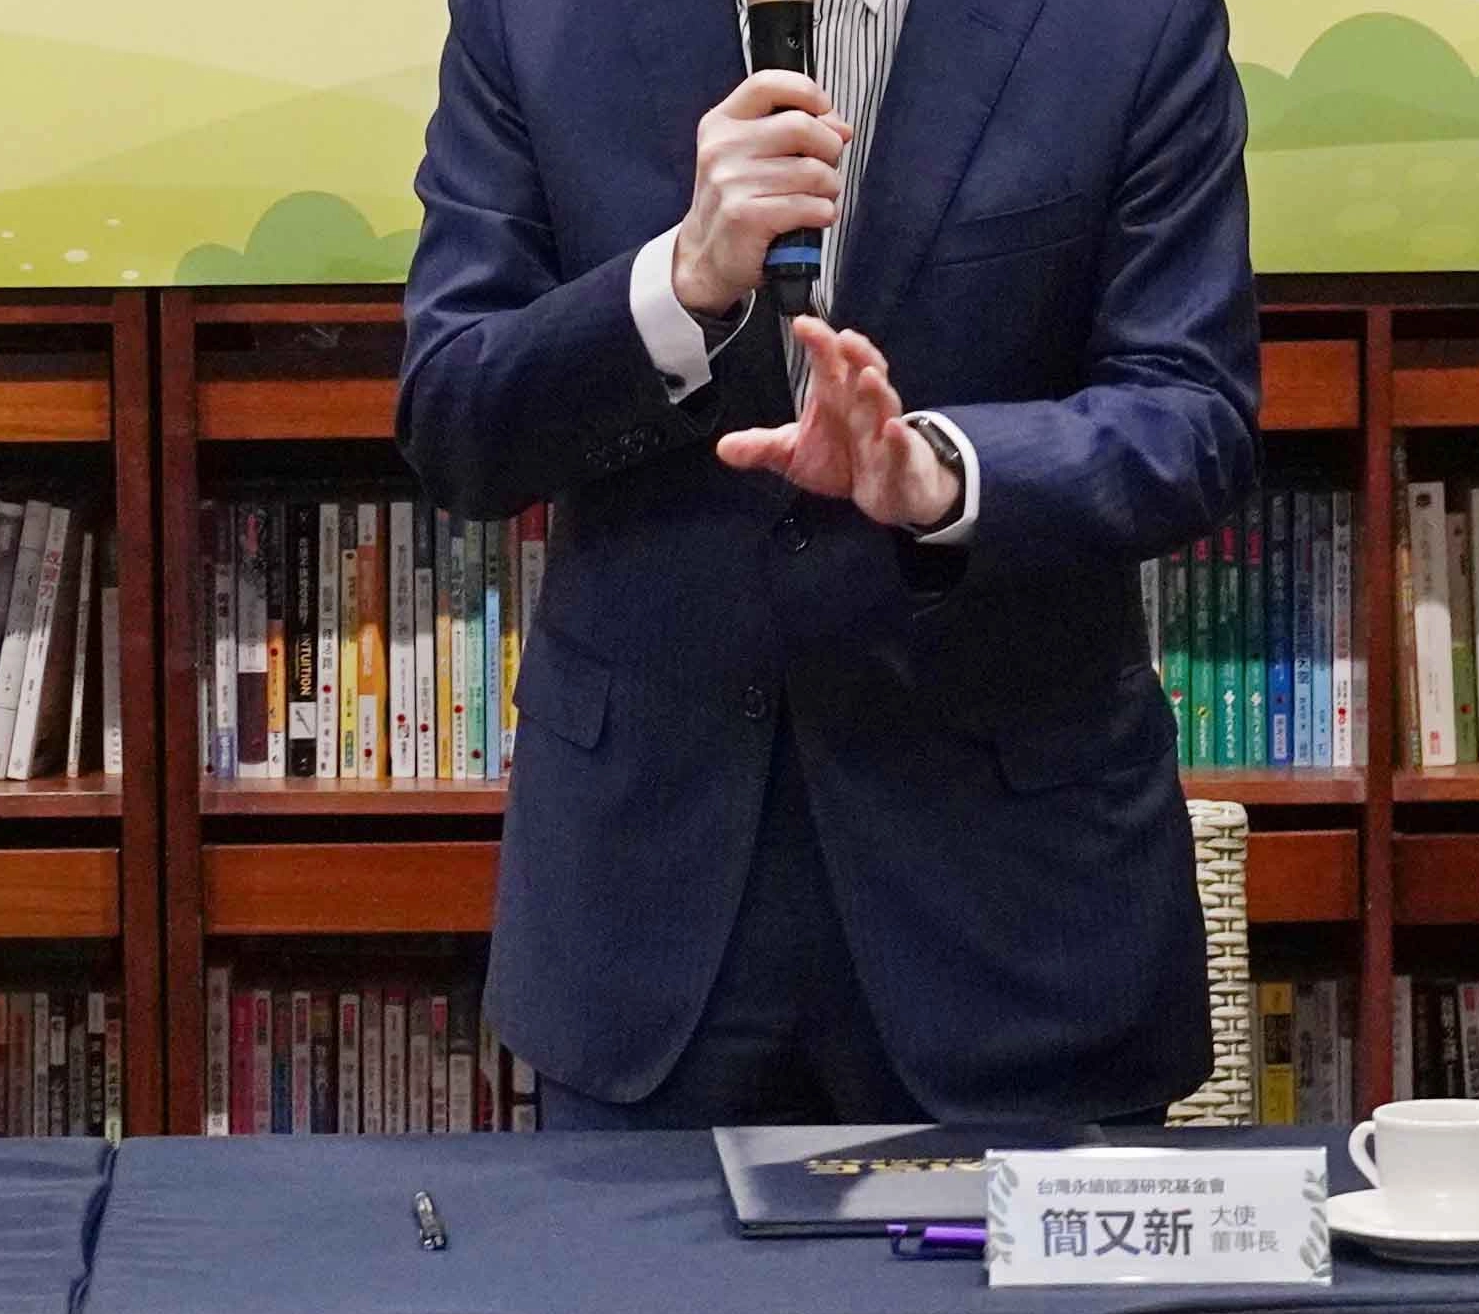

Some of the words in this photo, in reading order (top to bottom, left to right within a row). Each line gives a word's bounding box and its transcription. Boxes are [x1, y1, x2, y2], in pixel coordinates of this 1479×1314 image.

[1040, 1207, 1195, 1257] 簡又新
[1211, 1205, 1257, 1227] 大使
